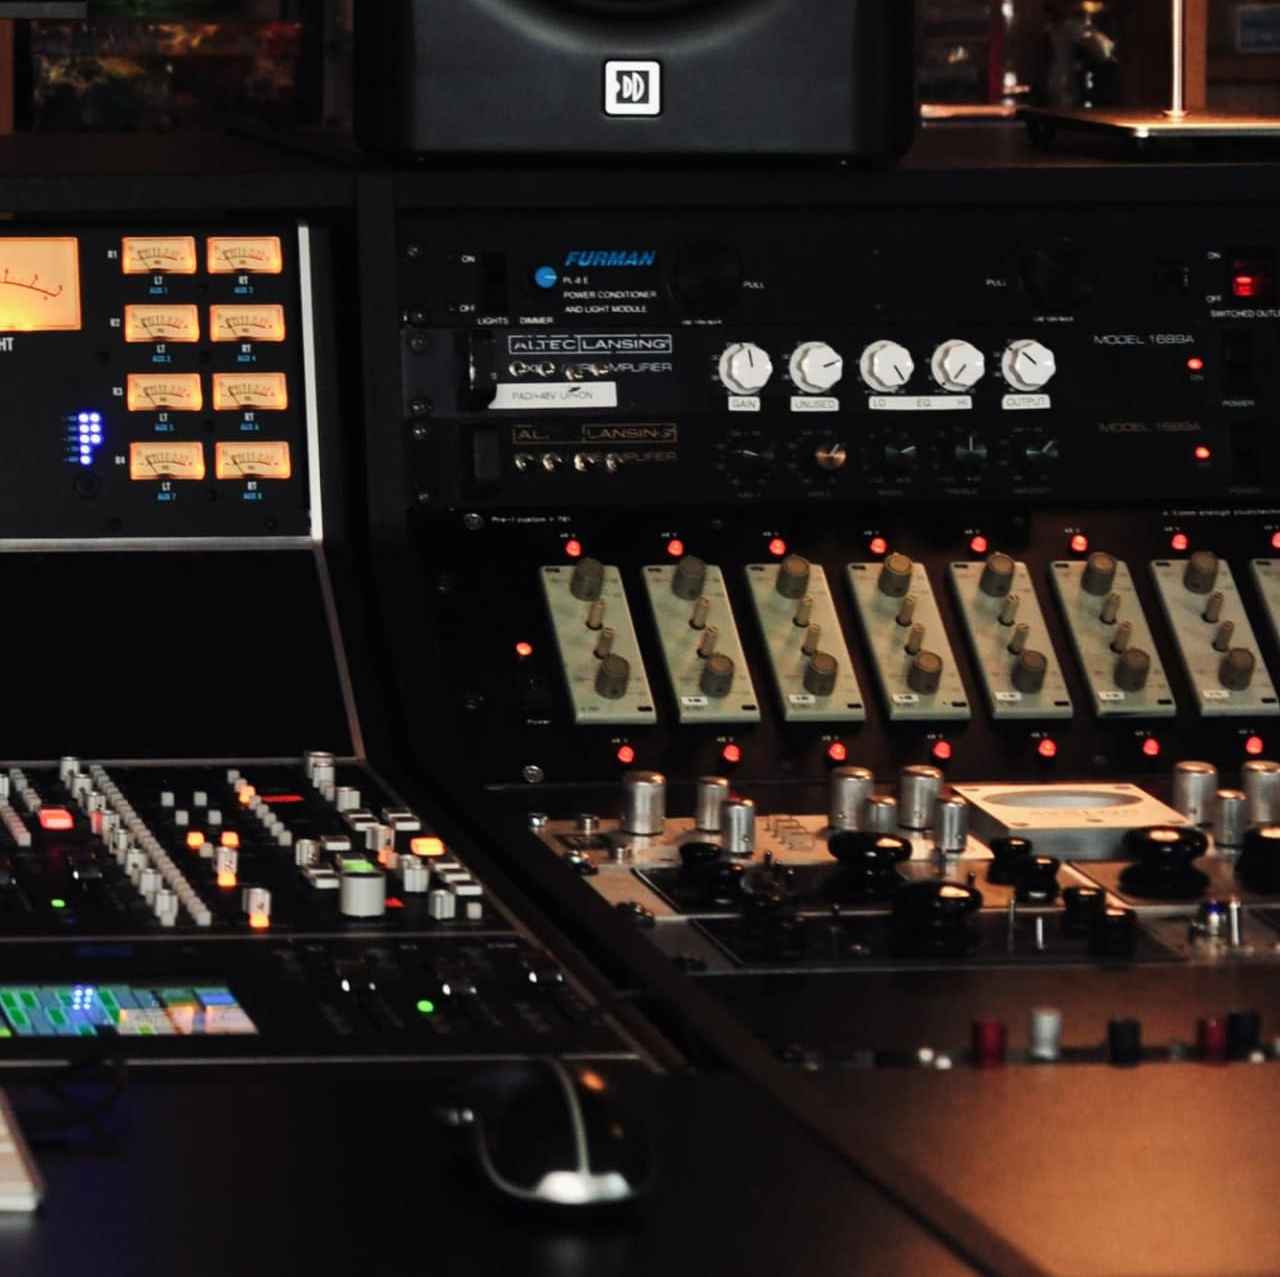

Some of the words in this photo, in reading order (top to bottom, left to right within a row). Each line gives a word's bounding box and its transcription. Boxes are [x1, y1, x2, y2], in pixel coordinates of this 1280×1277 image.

[461, 255, 476, 263] ON
[566, 252, 654, 266] FURMAN
[563, 290, 596, 299] POWER
[597, 290, 657, 299] CONDITIONER
[565, 305, 584, 314] AND
[584, 305, 610, 314] LIGHT
[611, 305, 646, 313] MODULE
[513, 339, 577, 351] ALTEC
[582, 338, 667, 350] LANSING
[1093, 334, 1145, 345] MODEL
[732, 396, 759, 409] GAIN
[794, 398, 838, 410] UNUSED
[873, 400, 887, 408] LO
[916, 399, 931, 408] EQ
[1006, 396, 1049, 409] OUTPUT
